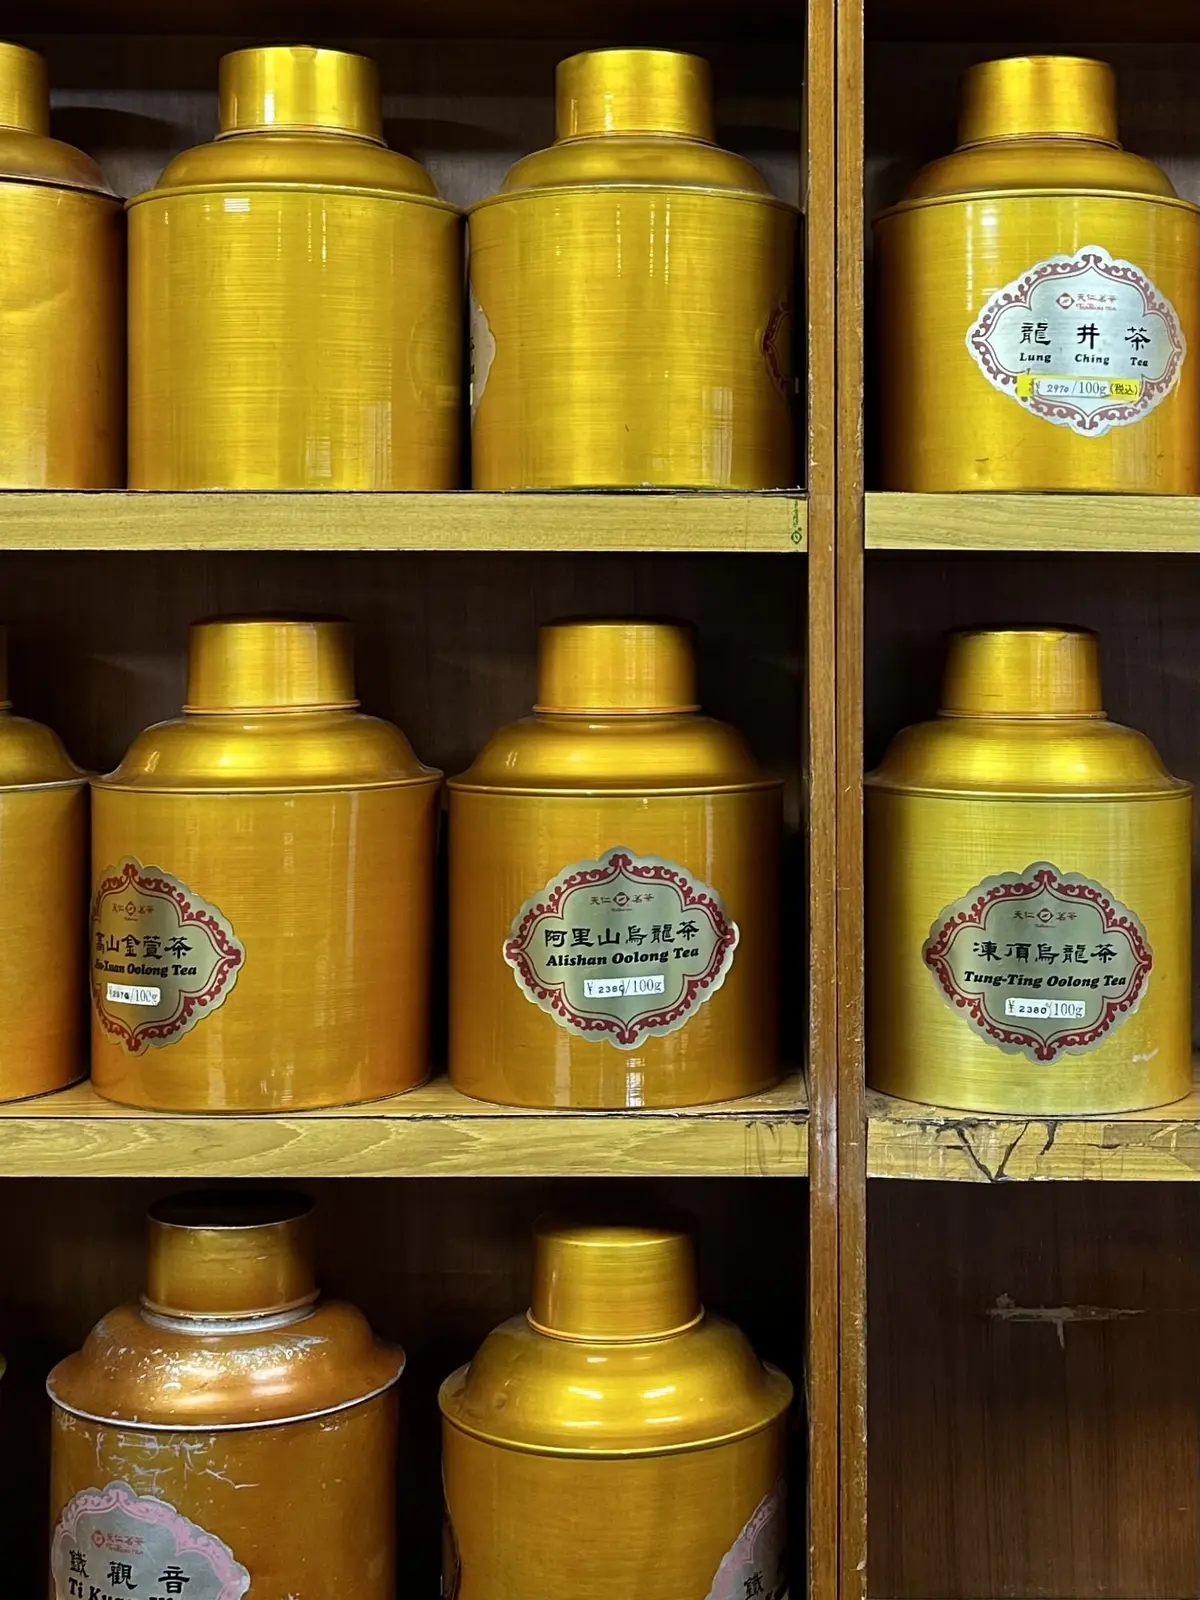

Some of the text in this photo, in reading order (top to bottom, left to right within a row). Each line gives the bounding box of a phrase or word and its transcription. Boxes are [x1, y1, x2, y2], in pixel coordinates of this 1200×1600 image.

[1019, 322, 1151, 350] 龍井茶
[1019, 352, 1149, 367] Lung Ching Tea
[544, 920, 700, 948] 阿里山烏龍茶
[545, 946, 699, 967] Alishan Oolong Tea
[127, 963, 168, 978] Oolong
[171, 965, 197, 977] Tea
[963, 971, 1126, 989] Tung-Ting Oolong Tea
[68, 1577, 84, 1598] Ti
